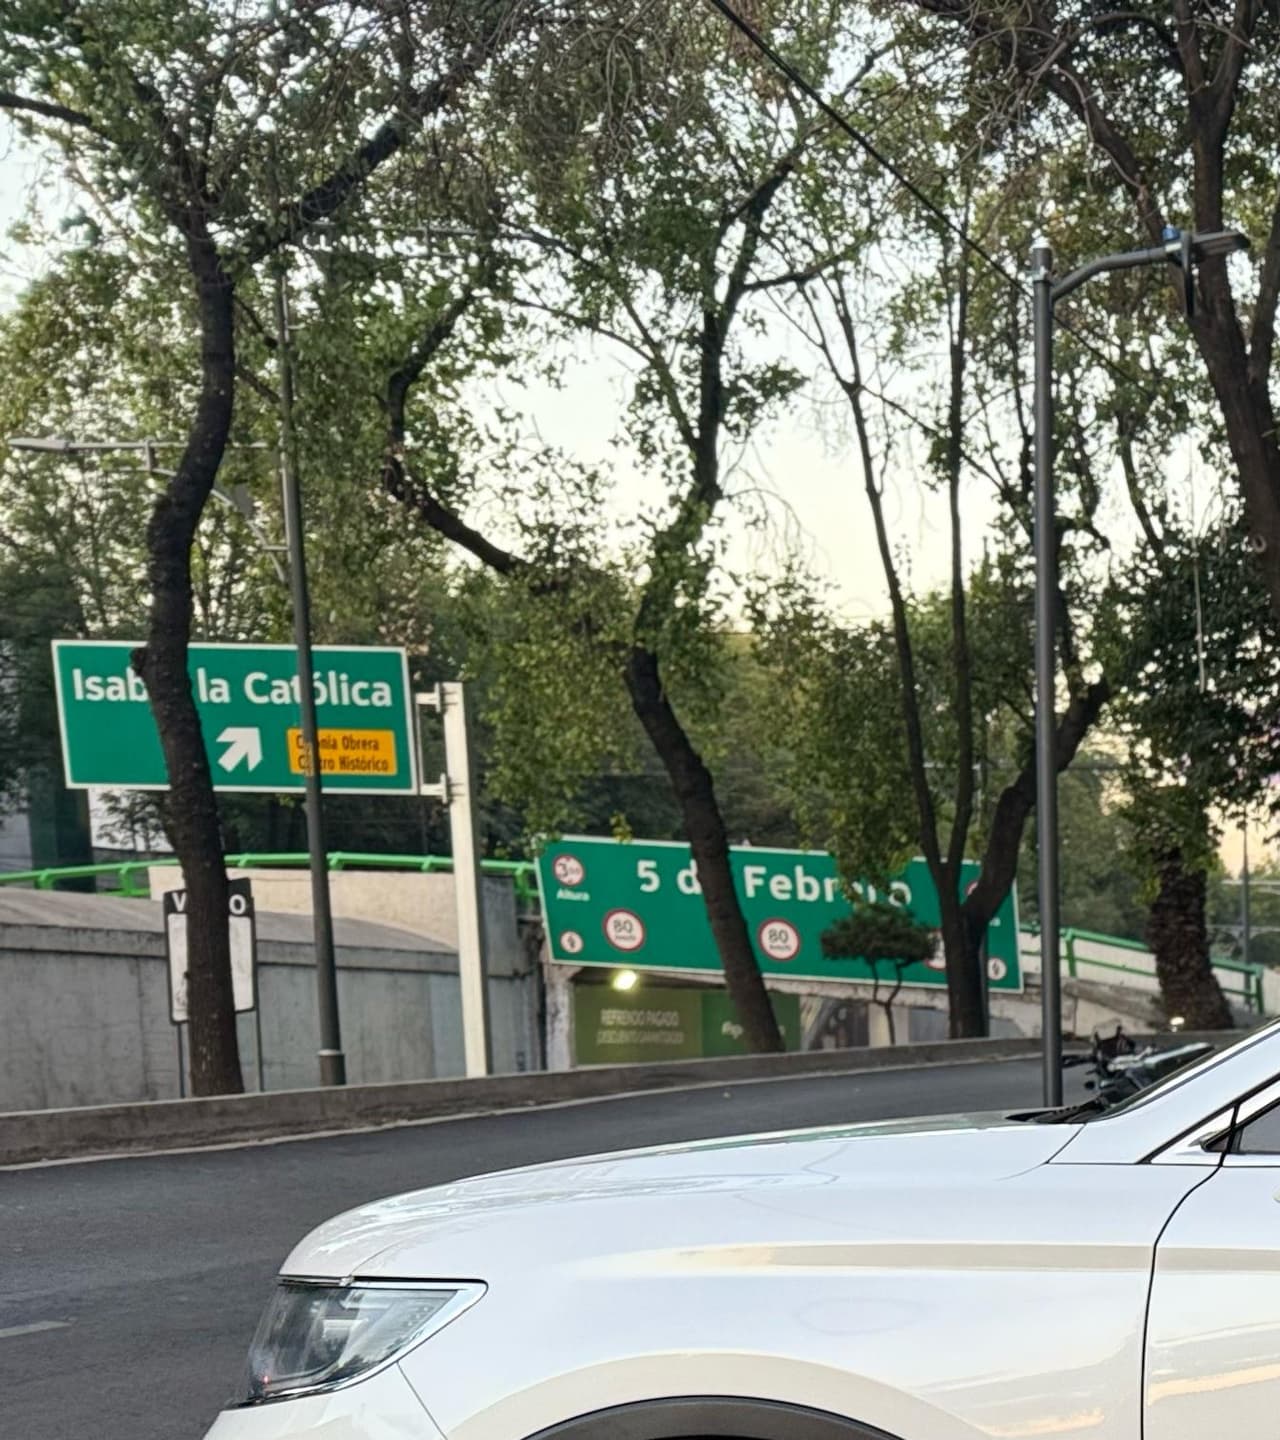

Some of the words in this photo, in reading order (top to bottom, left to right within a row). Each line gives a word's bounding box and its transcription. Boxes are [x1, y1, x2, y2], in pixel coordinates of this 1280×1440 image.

[637, 860, 661, 892] 5
[613, 919, 633, 934] 80
[768, 929, 789, 943] 80
